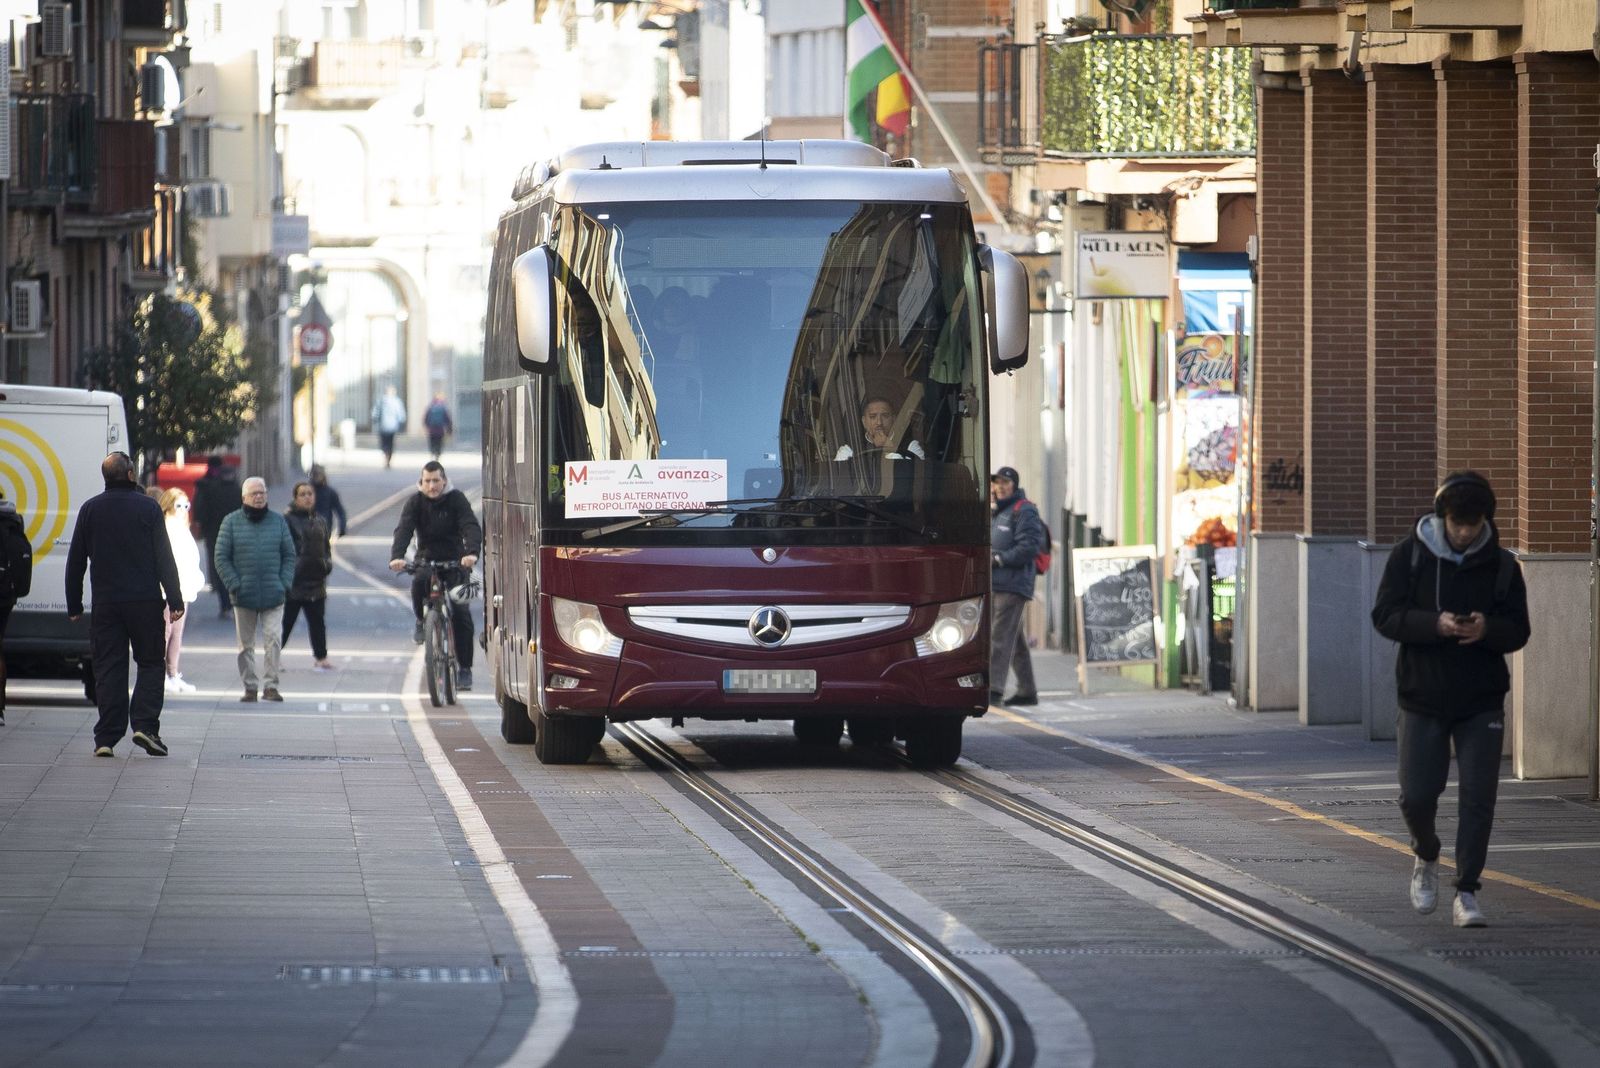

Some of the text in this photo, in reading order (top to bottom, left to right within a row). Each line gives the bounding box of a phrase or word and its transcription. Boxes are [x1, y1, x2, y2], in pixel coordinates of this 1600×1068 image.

[657, 470, 709, 480] avanza
[602, 491, 689, 501] BUS ALTERNATIVO
[573, 501, 653, 512] METROPOLITANO
[655, 501, 669, 510] DE
[17, 602, 50, 611] Operador
